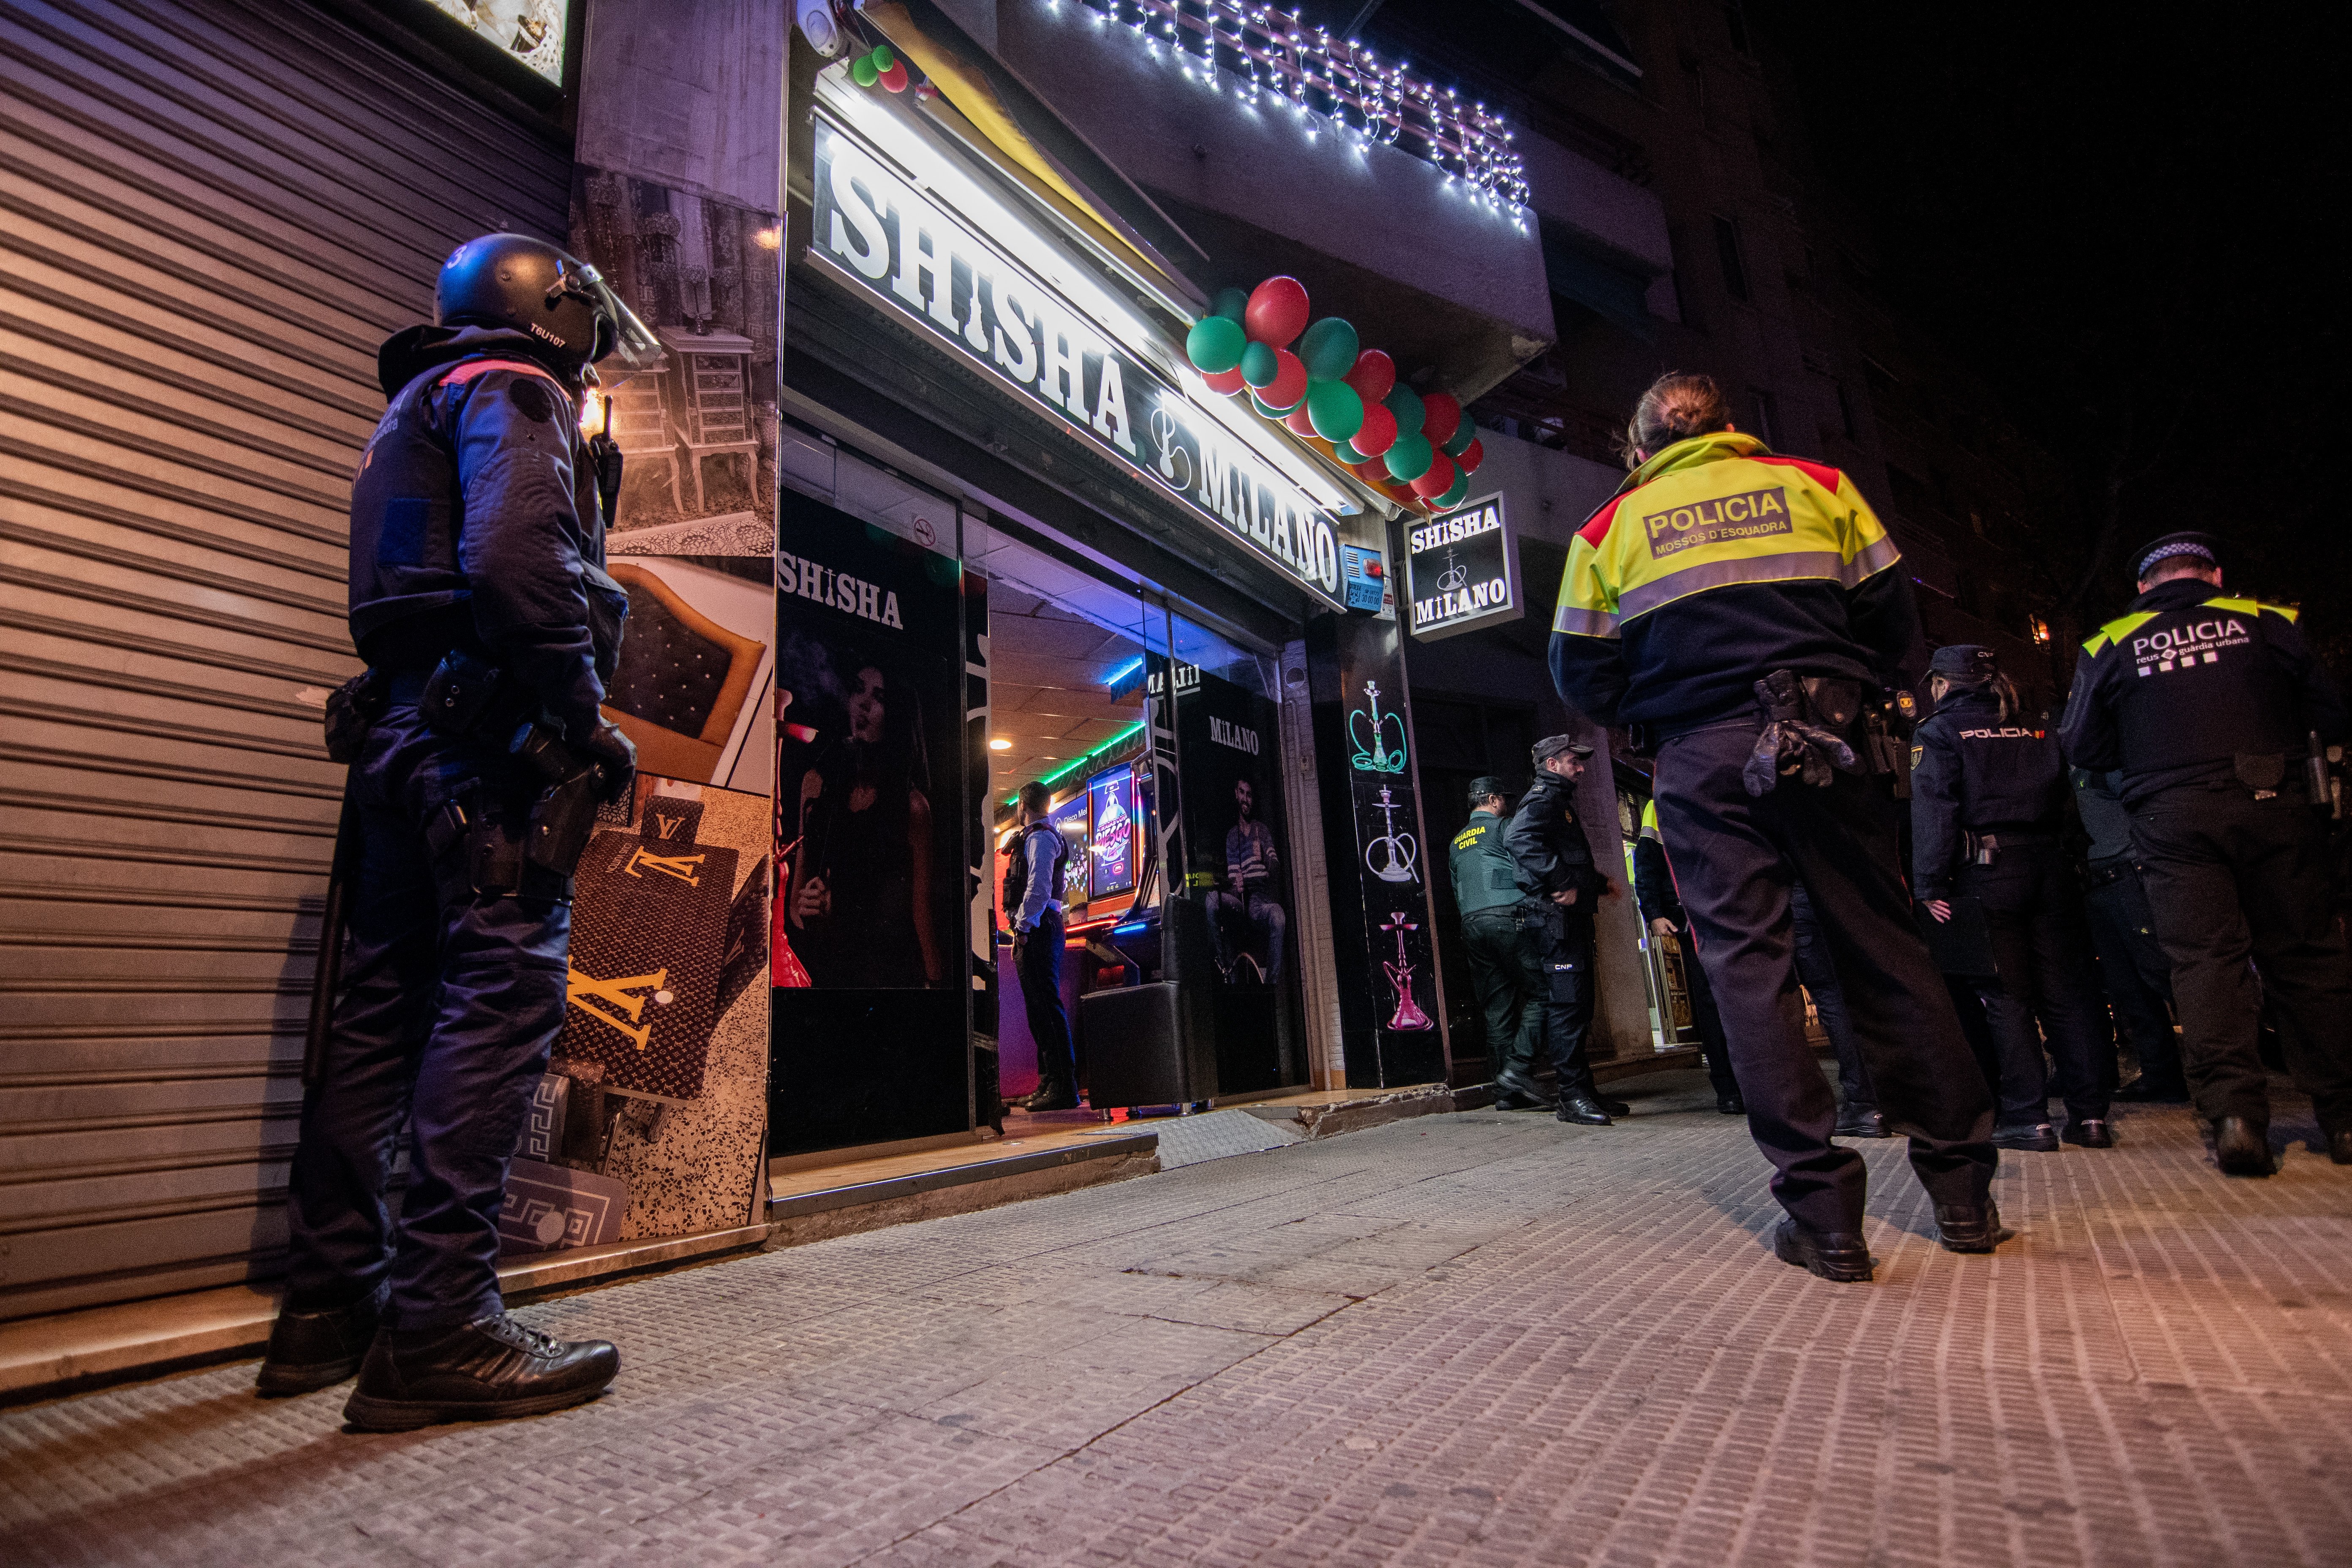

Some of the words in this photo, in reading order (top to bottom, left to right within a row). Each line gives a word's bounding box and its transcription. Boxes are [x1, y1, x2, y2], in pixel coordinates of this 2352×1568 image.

[447, 244, 467, 269] 3
[530, 322, 566, 348] T6U107
[830, 146, 1137, 458] SHISHA
[1199, 436, 1337, 593] MILANO
[1648, 493, 1783, 539] POLICIA
[1410, 506, 1500, 554] SHISHA
[1655, 533, 1707, 555] MOSSOS
[778, 550, 903, 630] SHISHA
[1416, 577, 1506, 625] MILANO
[2133, 619, 2246, 656] POLICIA
[2136, 653, 2160, 664] reus
[2178, 642, 2213, 655] guàrdia
[2216, 637, 2250, 647] urbana
[1209, 716, 1259, 756] MILANO
[1959, 727, 2033, 739] POLICIA
[1064, 814, 1077, 824] Disco
[1454, 826, 1485, 844] GUARDIA
[1459, 837, 1478, 849] CIVIL
